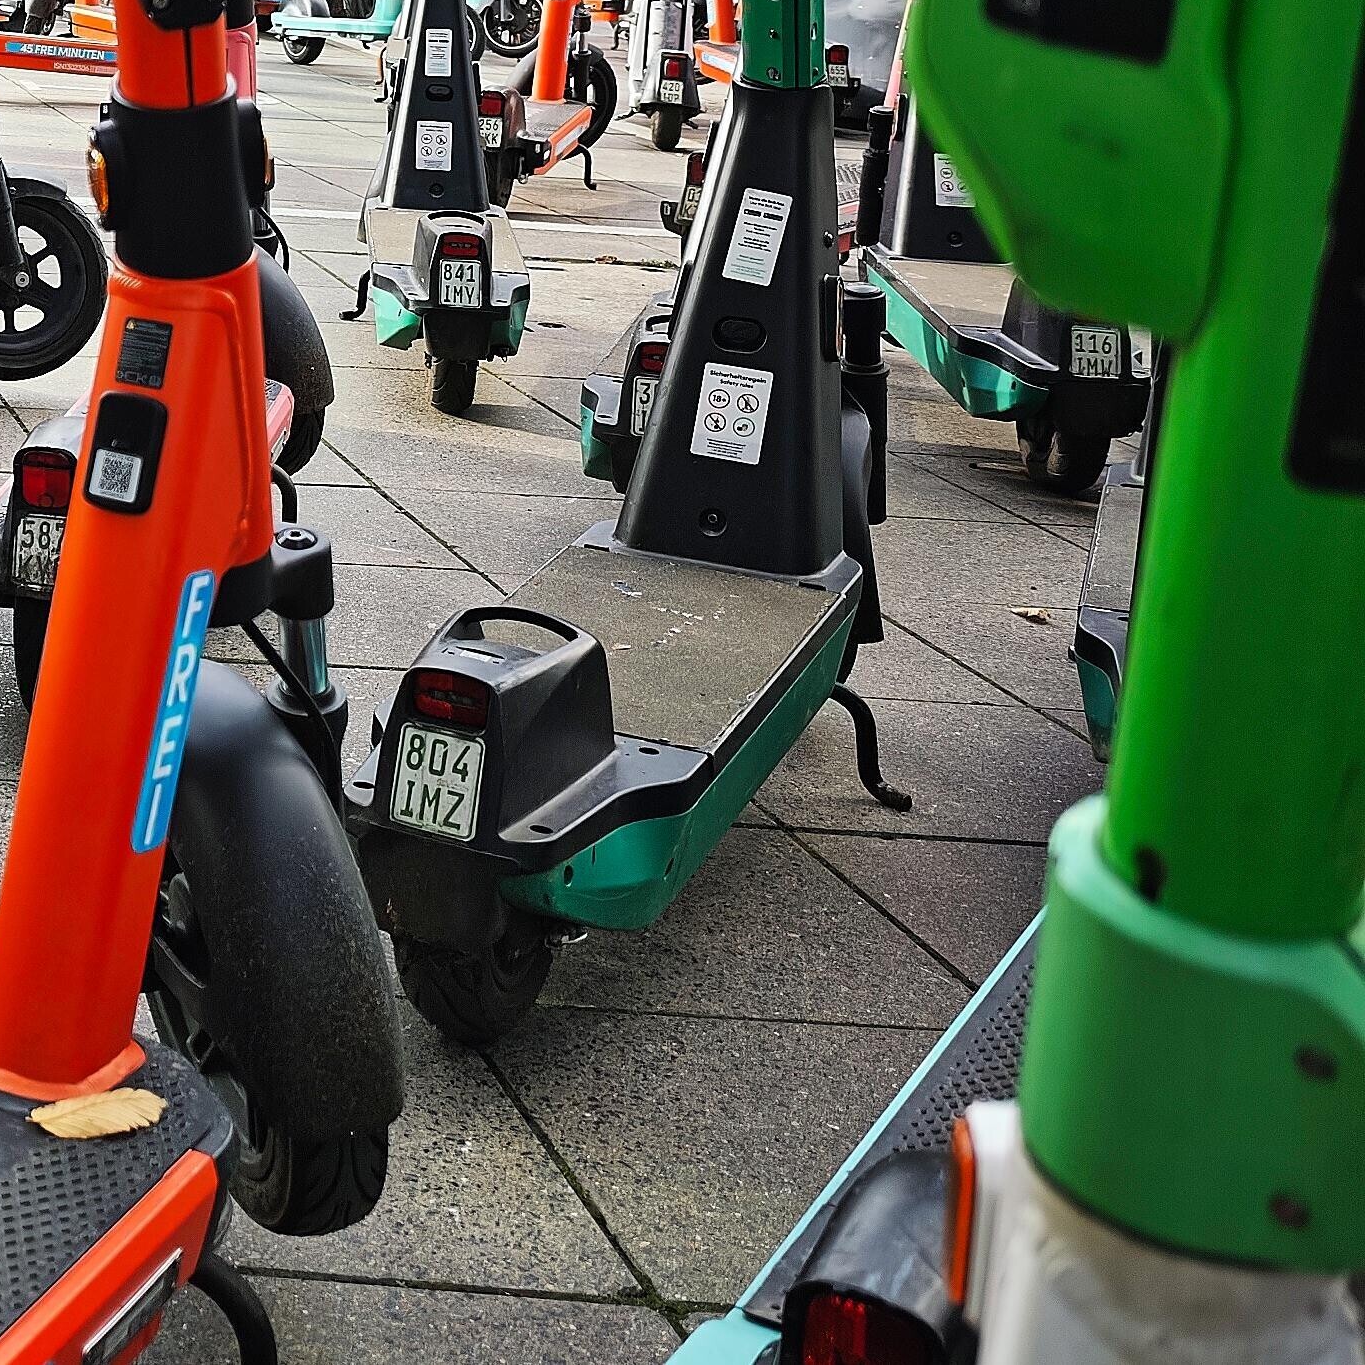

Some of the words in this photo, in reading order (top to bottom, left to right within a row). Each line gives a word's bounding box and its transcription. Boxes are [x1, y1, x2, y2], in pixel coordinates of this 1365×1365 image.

[20, 43, 34, 55] 45
[34, 45, 58, 57] FREI
[58, 47, 106, 61] MINUTEN
[662, 82, 680, 92] 420
[478, 118, 500, 130] 256
[443, 263, 476, 282] 841
[443, 284, 475, 304] IMY
[1074, 333, 1114, 354] 116
[709, 370, 769, 385] Sicherheitsregeln
[718, 379, 740, 387] Safety
[712, 394, 727, 403] 18+
[143, 574, 211, 847] FREI
[406, 733, 471, 783] 804
[399, 779, 466, 831] IMZ
